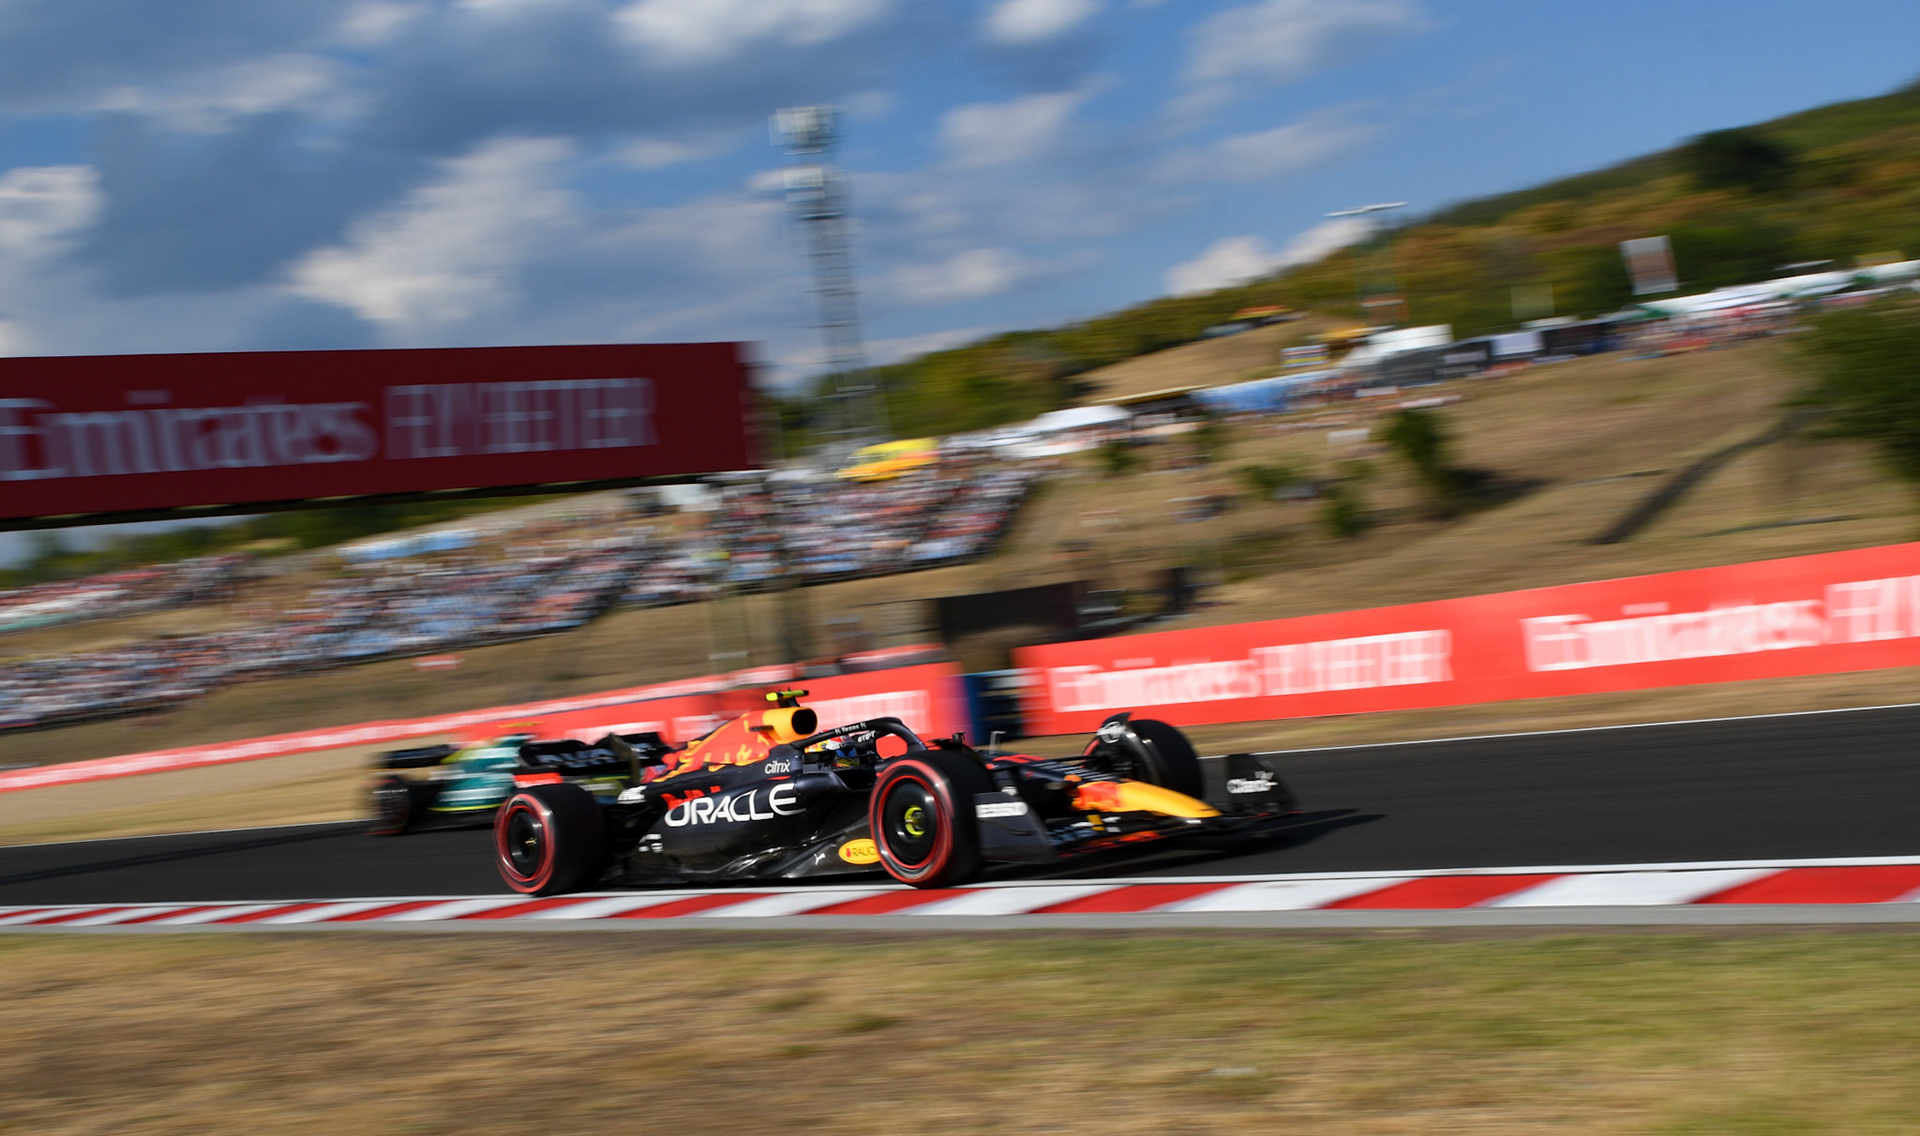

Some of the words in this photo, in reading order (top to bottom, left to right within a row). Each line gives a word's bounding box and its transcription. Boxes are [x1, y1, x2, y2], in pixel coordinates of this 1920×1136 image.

[0, 389, 379, 481] Emirates
[1518, 598, 1832, 672] Emirates
[664, 782, 807, 828] ORACLE
[852, 845, 876, 857] RAUC
